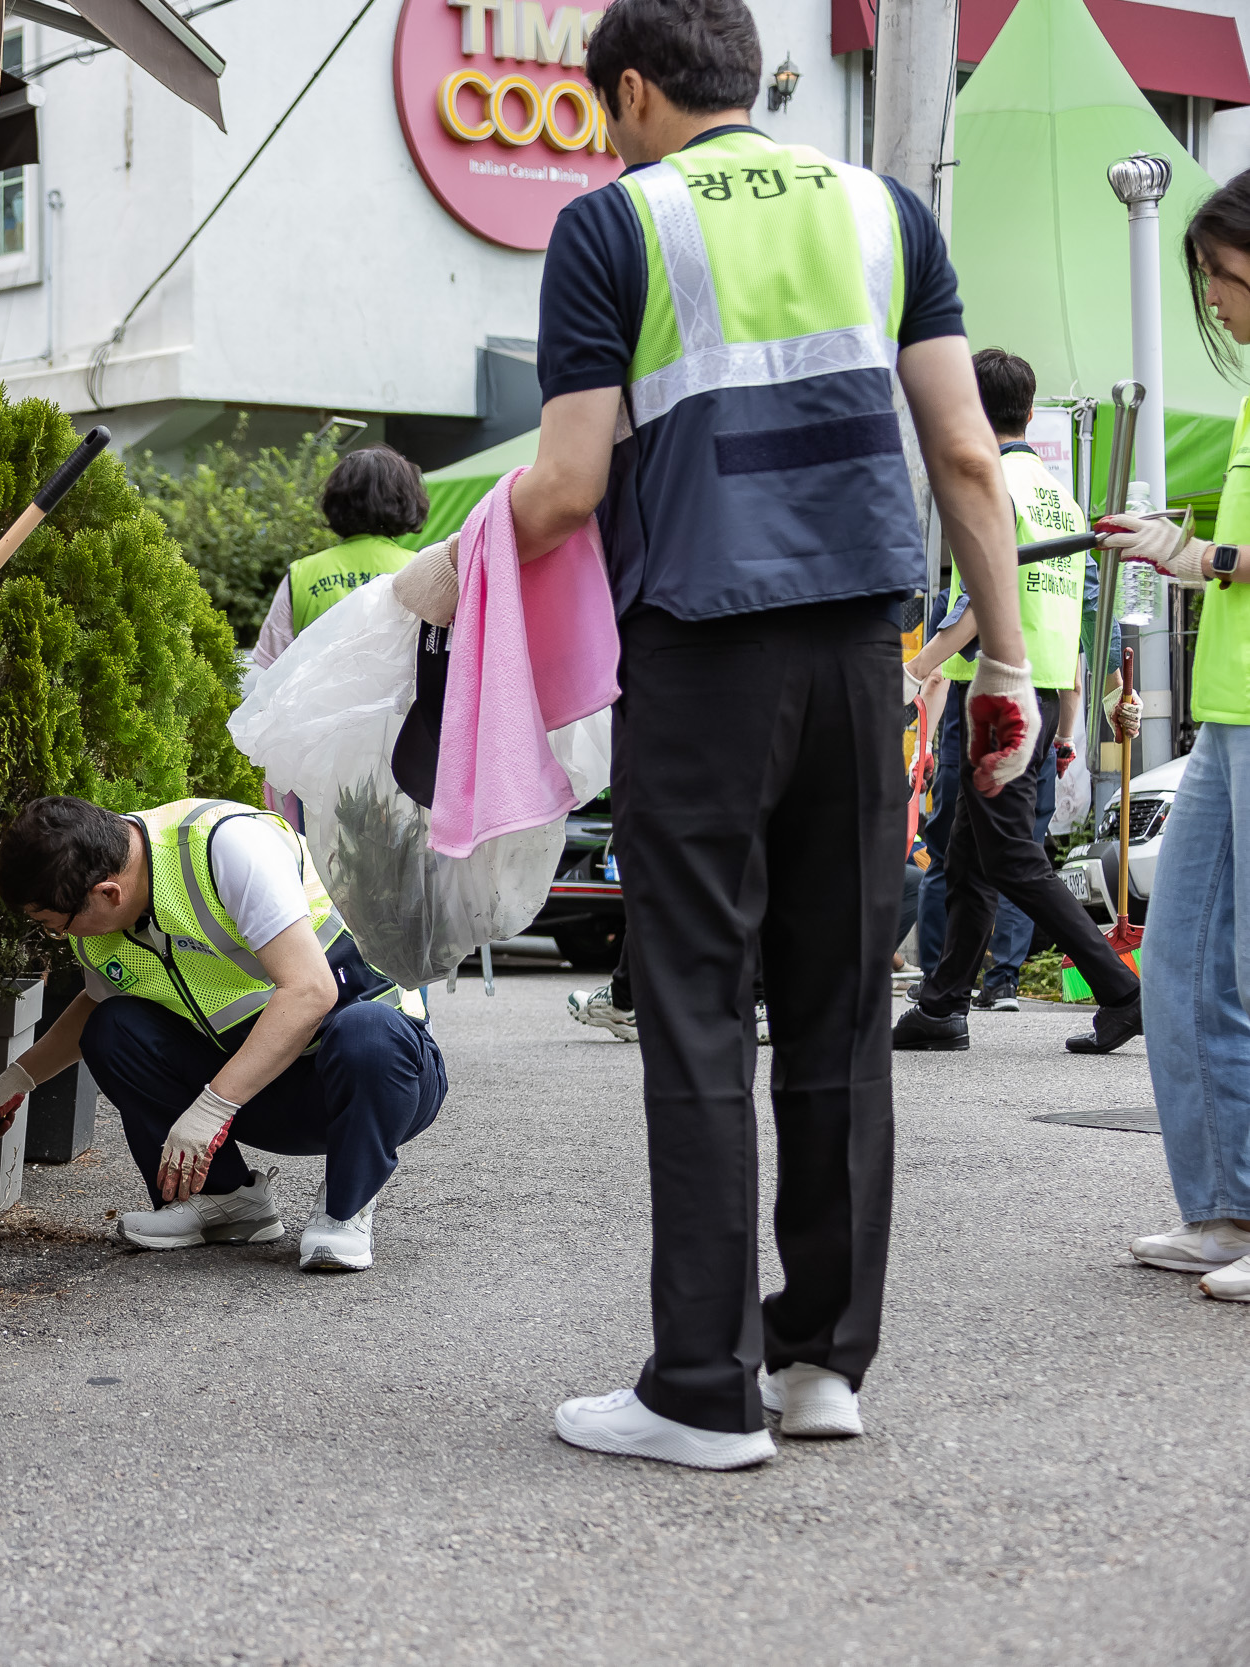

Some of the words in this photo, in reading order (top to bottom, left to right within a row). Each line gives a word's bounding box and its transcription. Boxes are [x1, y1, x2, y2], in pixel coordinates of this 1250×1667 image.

[469, 159, 508, 177] Italian
[509, 163, 548, 181] Casual
[549, 167, 589, 188] Dining
[688, 165, 838, 201] 광진구
